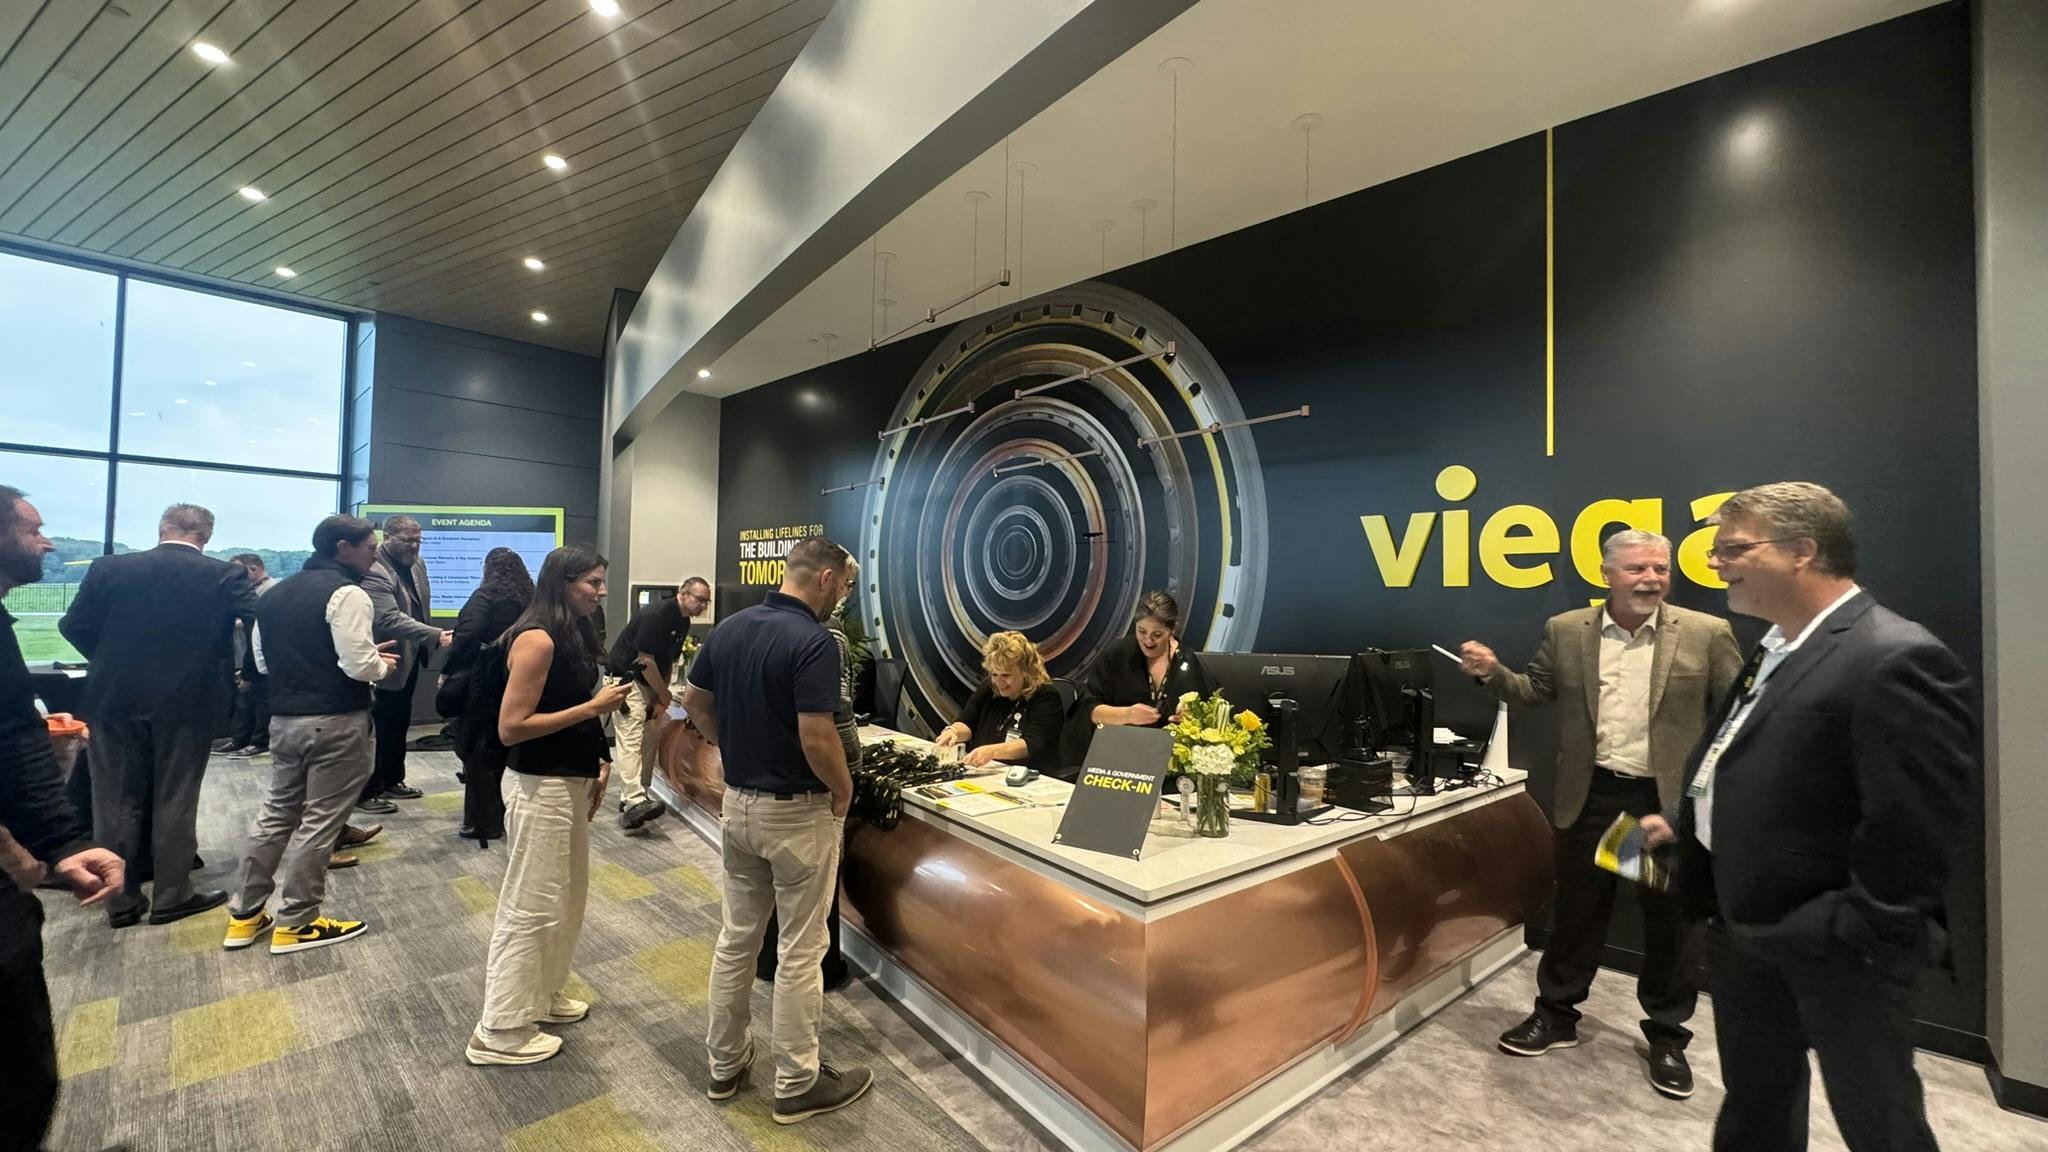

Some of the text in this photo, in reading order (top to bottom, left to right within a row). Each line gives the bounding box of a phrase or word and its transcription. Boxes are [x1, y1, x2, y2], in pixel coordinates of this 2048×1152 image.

[431, 518, 458, 526] EVENT
[740, 524, 824, 541] INSTALLING LIFELINES FOR
[740, 539, 804, 558] THE BUILDIN
[739, 560, 787, 585] TOMOR
[1260, 666, 1295, 675] ASUS
[1083, 774, 1153, 794] CHECK-IN
[1112, 771, 1155, 781] GOVERNMENT
